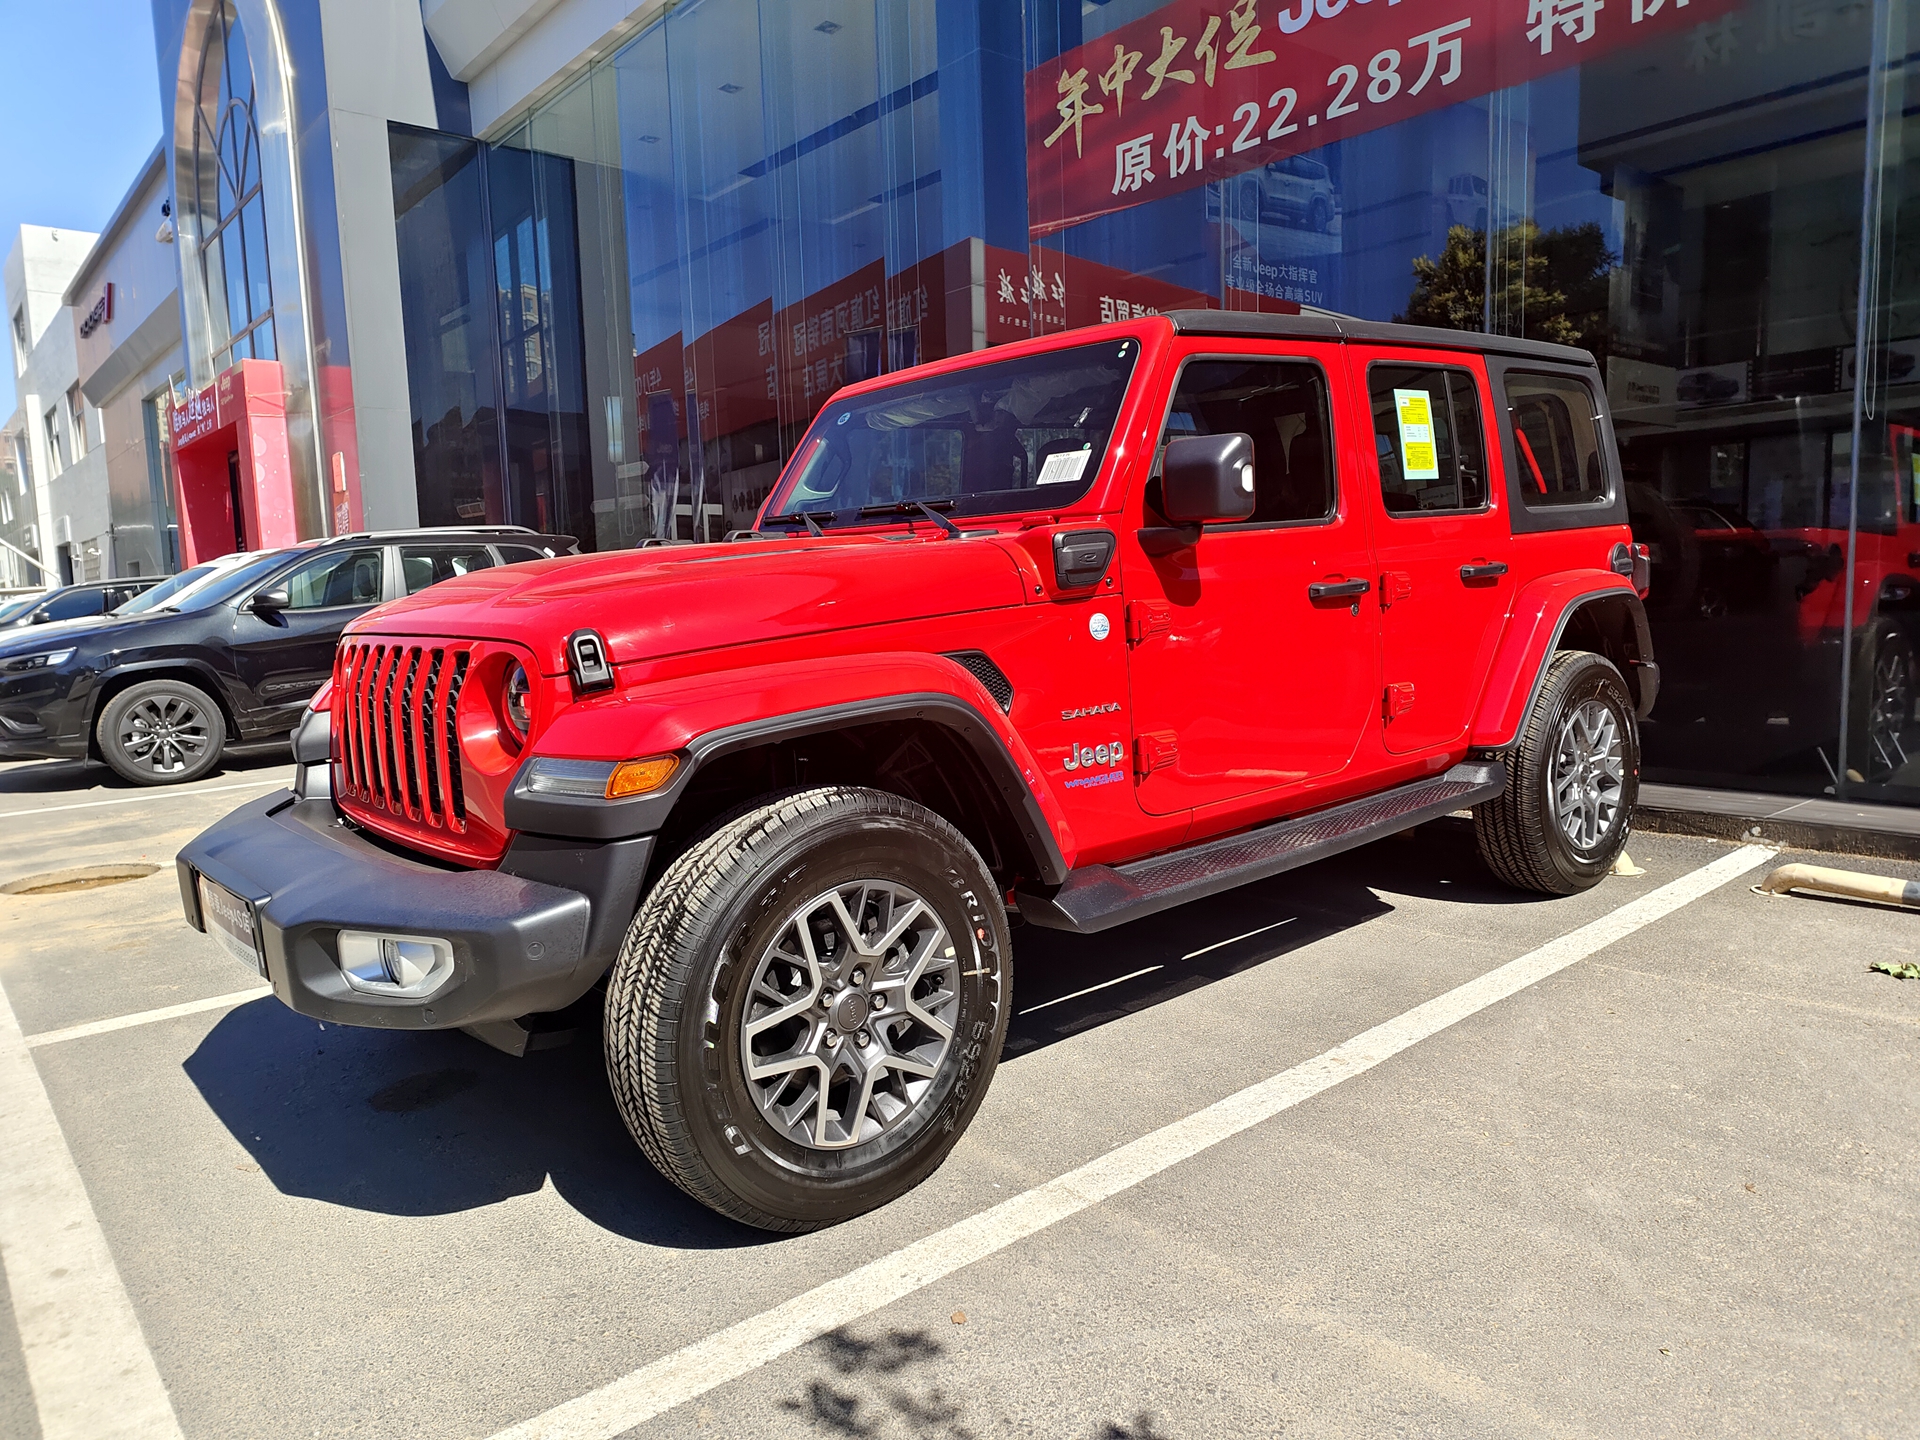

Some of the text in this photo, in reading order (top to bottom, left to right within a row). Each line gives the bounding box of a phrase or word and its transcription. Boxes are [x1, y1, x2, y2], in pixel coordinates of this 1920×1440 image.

[1043, 0, 1277, 159] 年中大促
[1111, 17, 1472, 195] 原价:22.28万
[1232, 254, 1318, 284] 全新Jeep大指挥官
[1061, 702, 1121, 720] SAHARA
[1063, 741, 1124, 771] Jeep
